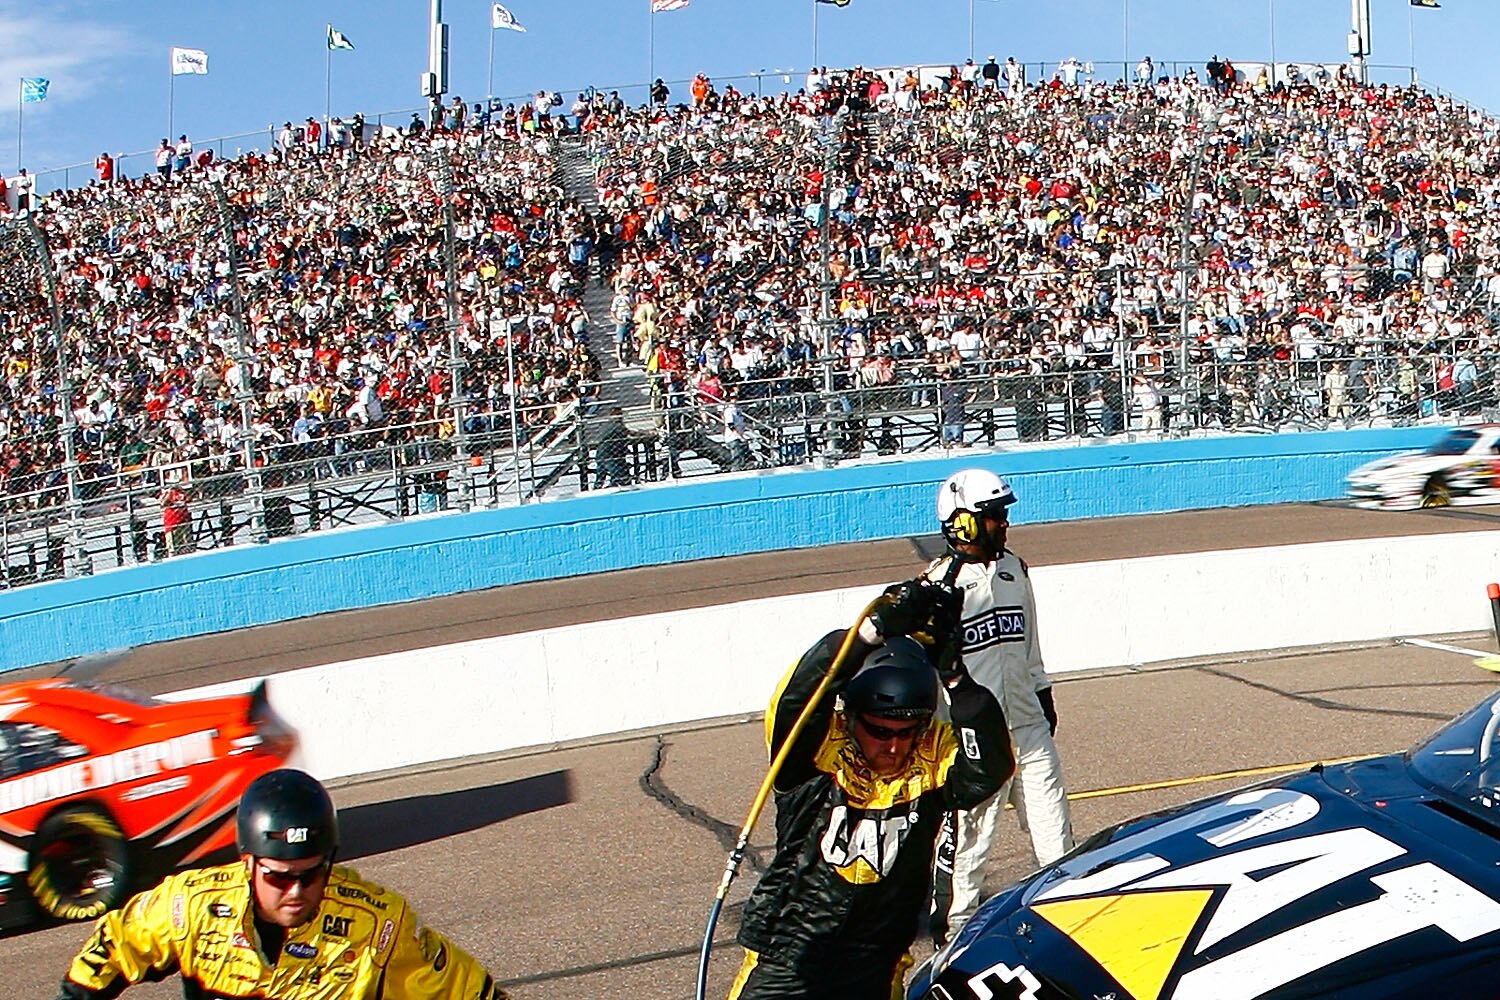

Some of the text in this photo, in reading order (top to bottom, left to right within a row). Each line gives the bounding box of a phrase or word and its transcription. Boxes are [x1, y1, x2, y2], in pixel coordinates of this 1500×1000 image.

[286, 827, 309, 843] CAT
[821, 805, 909, 877] CAT
[322, 914, 355, 937] CAT
